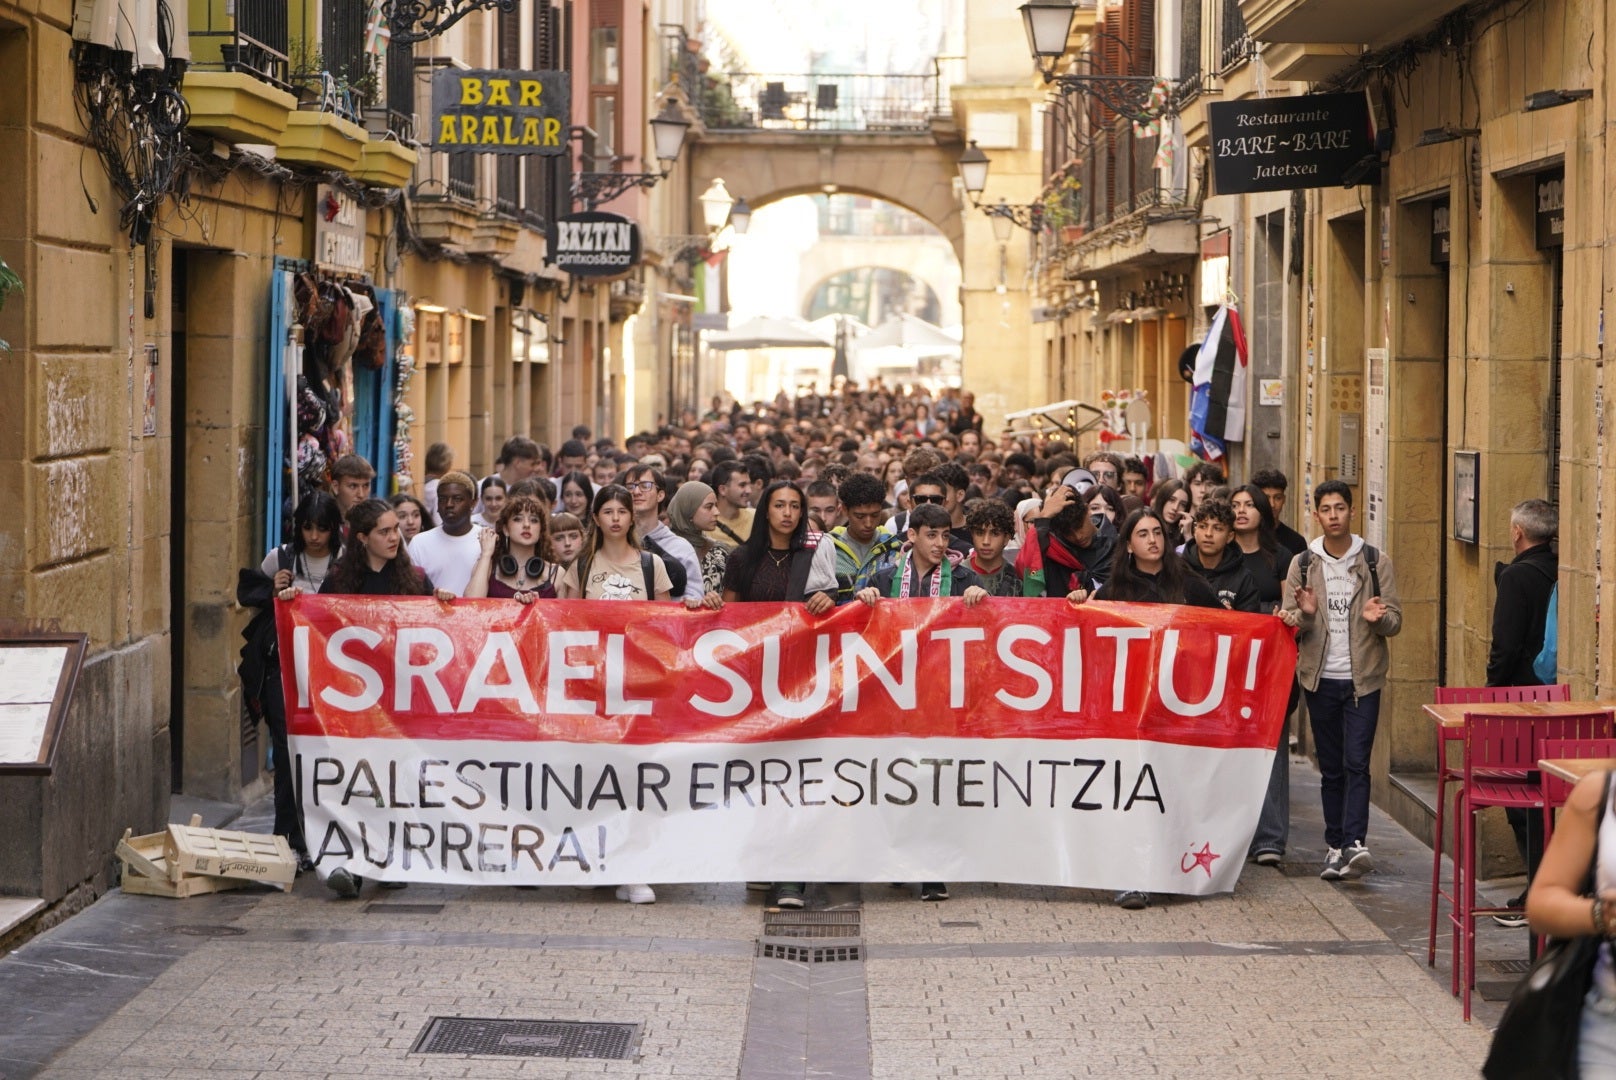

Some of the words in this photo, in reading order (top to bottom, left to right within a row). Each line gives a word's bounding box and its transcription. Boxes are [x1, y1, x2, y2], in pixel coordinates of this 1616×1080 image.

[461, 78, 543, 106] BAR
[438, 114, 561, 146] ARALAR
[1236, 109, 1330, 127] Restaurante
[1252, 164, 1318, 180] Jatetxea
[557, 221, 631, 251] BAZTAN
[293, 626, 653, 715] ISRAEL
[689, 624, 1262, 719] SUNTSITU!
[688, 757, 1166, 814] ERRESISTENTZIA
[314, 820, 607, 873] AURRERA!
